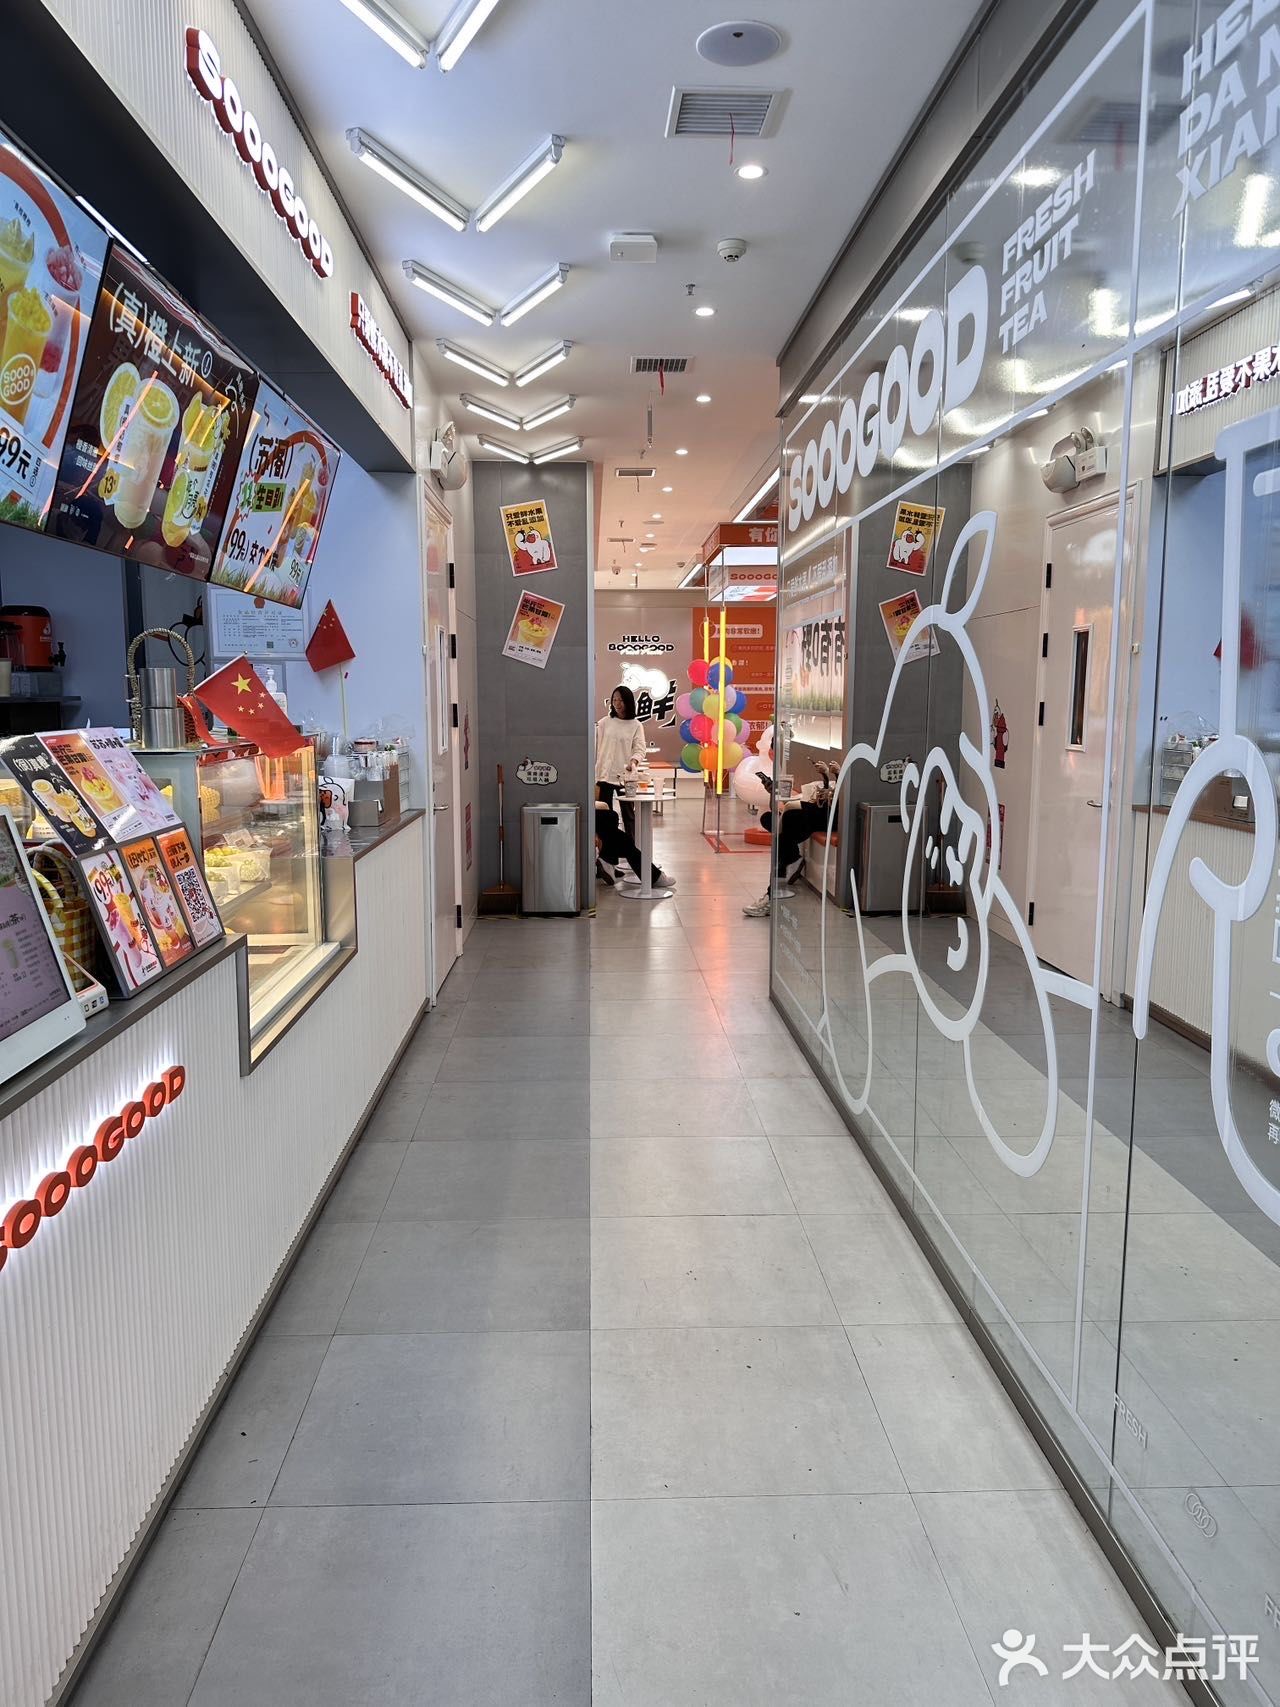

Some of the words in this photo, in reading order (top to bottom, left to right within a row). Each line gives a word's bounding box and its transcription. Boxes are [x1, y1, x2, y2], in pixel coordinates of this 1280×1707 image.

[184, 25, 334, 279] SOOOGOOD
[1001, 148, 1097, 276] FRESH
[1000, 215, 1080, 317] FRUIT
[998, 290, 1049, 354] TEA
[3, 379, 31, 397] GOOD
[788, 264, 989, 532] SOOOGOOD
[622, 635, 660, 643] HELLO
